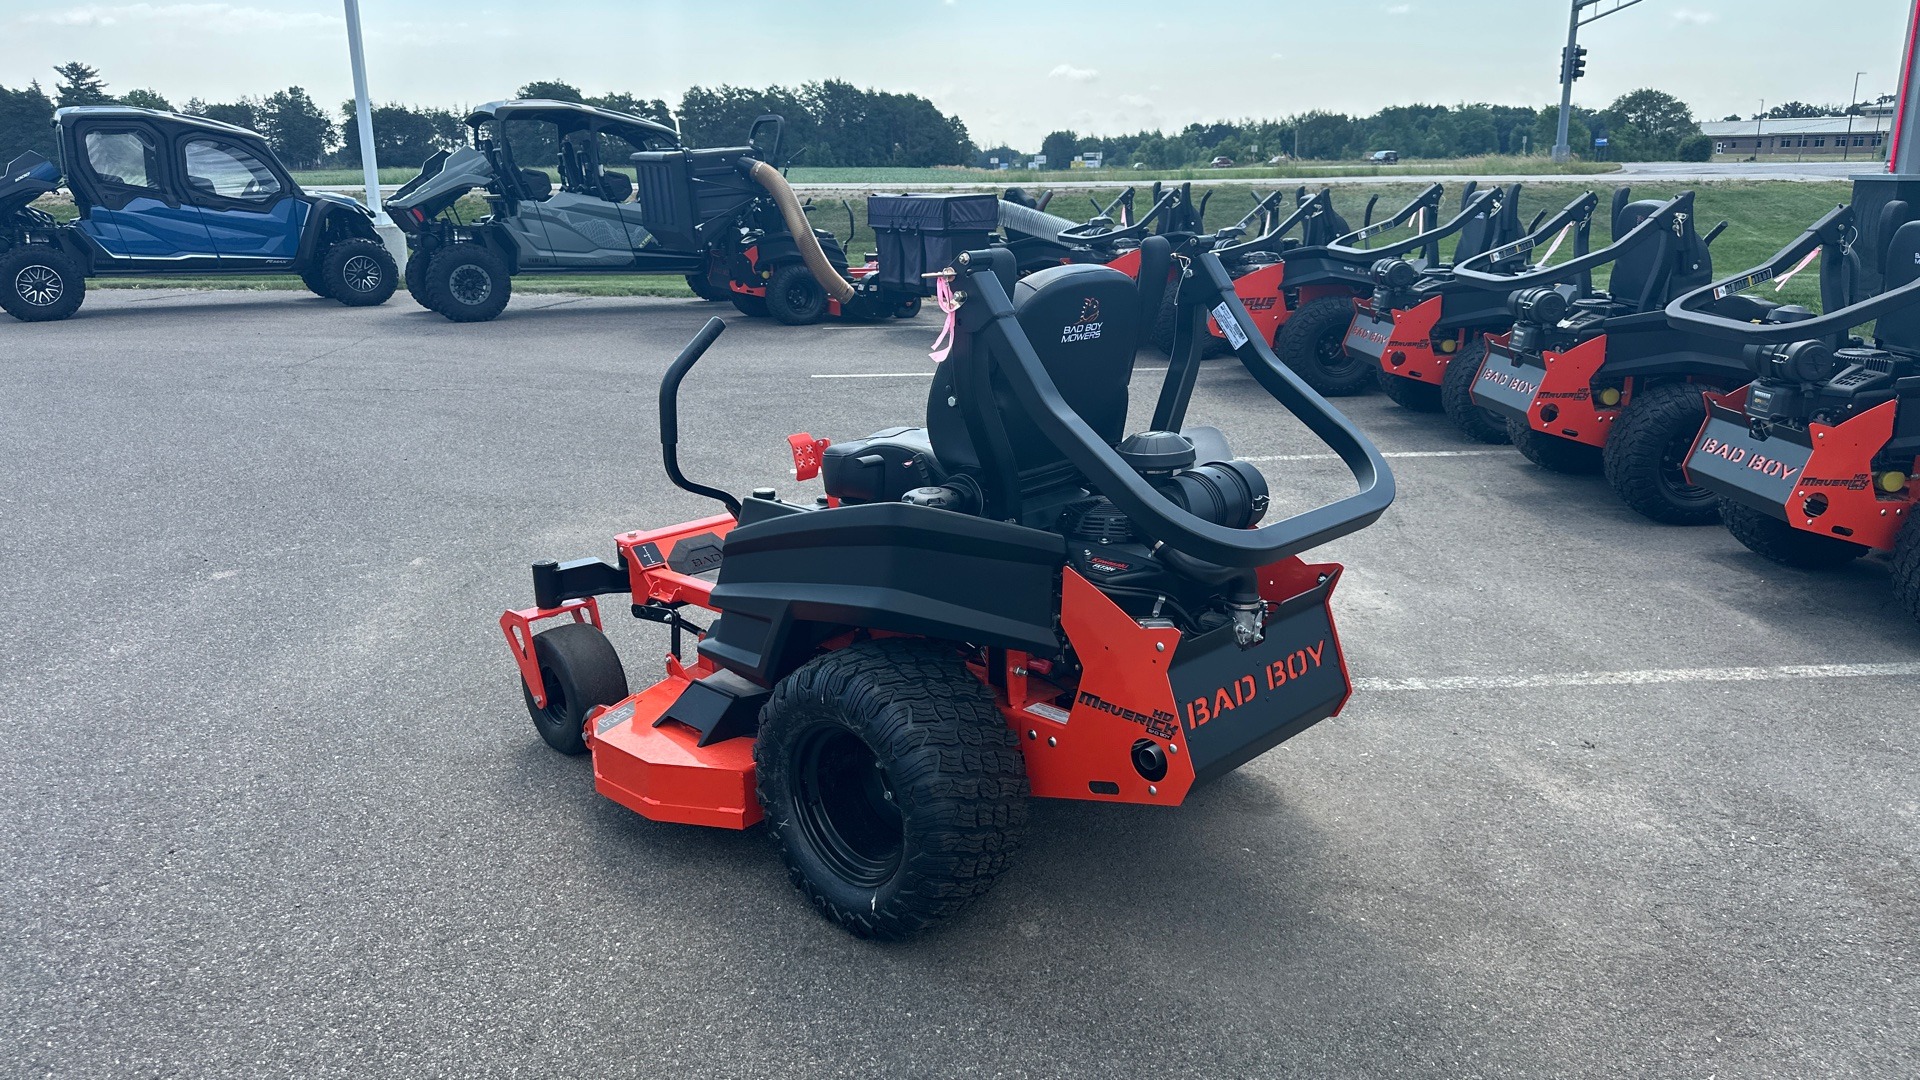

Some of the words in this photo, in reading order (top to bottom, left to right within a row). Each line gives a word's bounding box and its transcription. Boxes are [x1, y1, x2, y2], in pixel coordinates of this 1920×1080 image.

[1063, 324, 1084, 335] BAD
[1085, 322, 1103, 332] BOY
[1061, 330, 1102, 343] MOWERS
[1482, 367, 1509, 385] BAD
[1509, 376, 1538, 396] BOY
[1538, 391, 1590, 399] MAVERICK
[1701, 436, 1746, 464] BAD
[1747, 453, 1799, 481] BOY
[1800, 477, 1871, 488] MAVERICK
[691, 552, 723, 568] BAD
[1186, 673, 1257, 731] BAD
[1265, 640, 1325, 691] BOY
[1078, 690, 1179, 737] MAVERICK
[1153, 708, 1175, 723] HD
[1148, 728, 1160, 736] BAD
